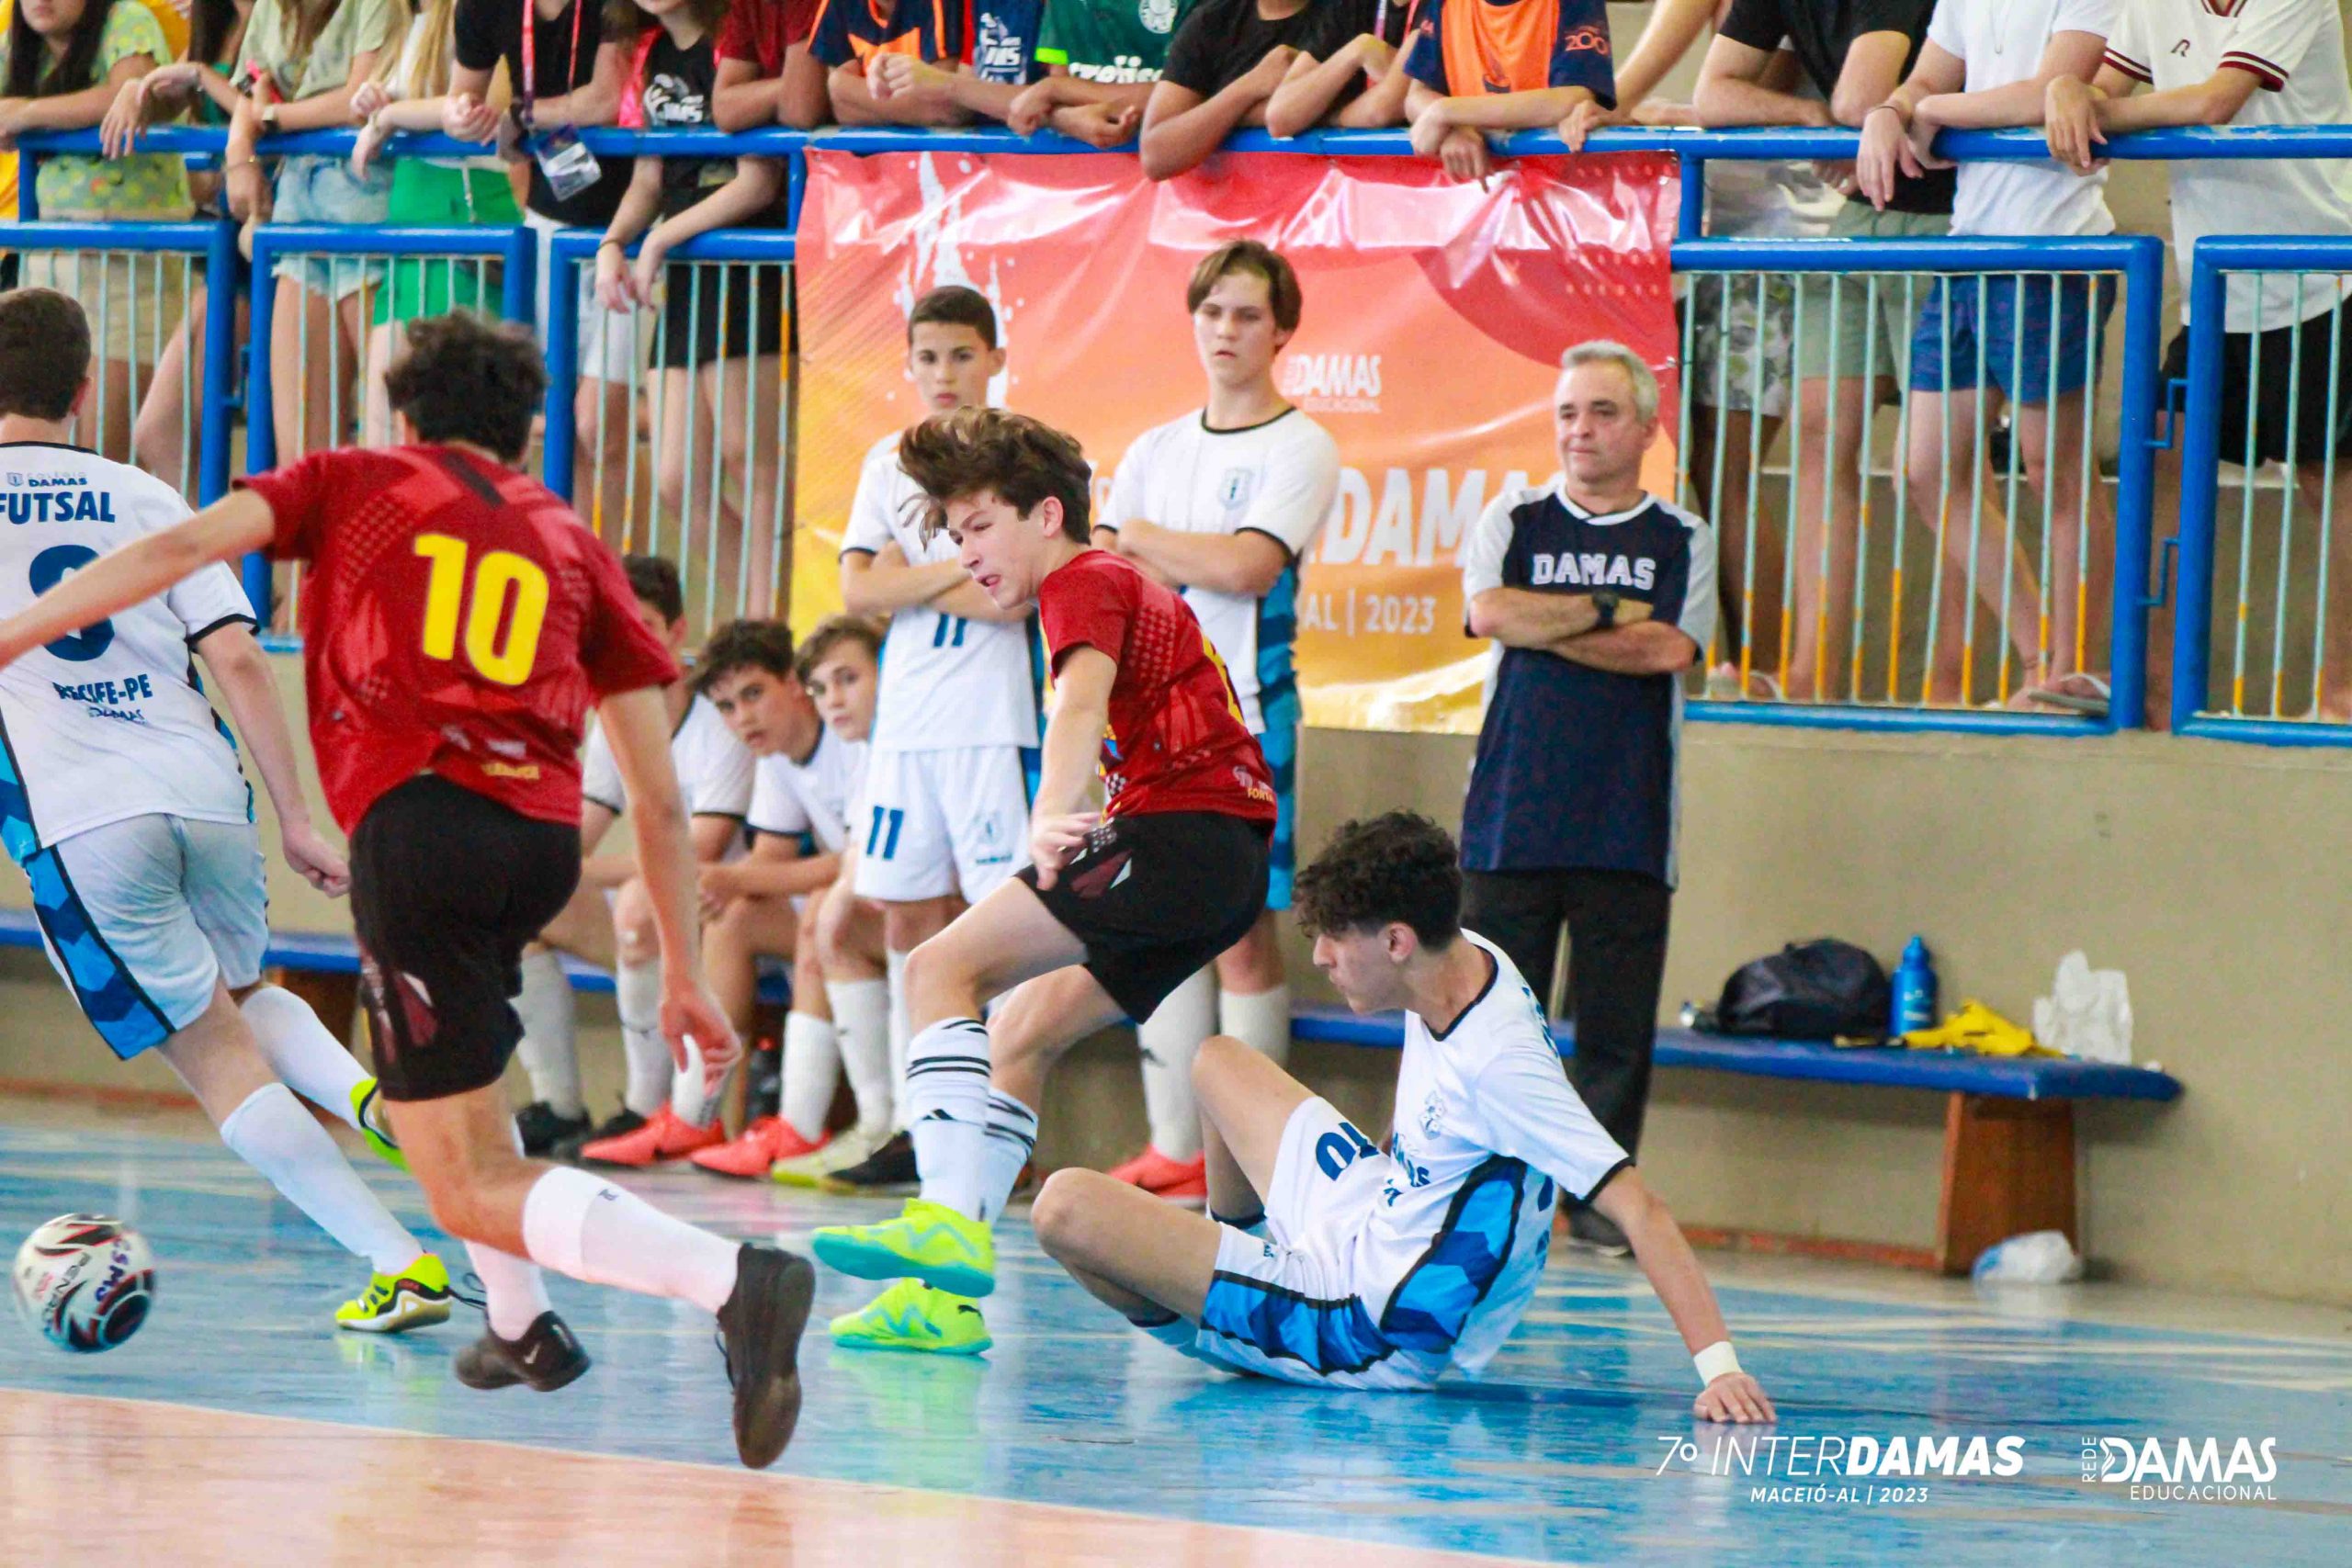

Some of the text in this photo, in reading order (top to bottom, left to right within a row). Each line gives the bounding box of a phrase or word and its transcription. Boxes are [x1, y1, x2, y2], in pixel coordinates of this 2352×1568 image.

[1293, 354, 1382, 397] DAMAS
[28, 477, 88, 488] DAMAS
[1532, 553, 1657, 591] DAMAS
[414, 533, 550, 686] 10
[1365, 594, 1437, 635] 2023
[865, 805, 905, 861] 11
